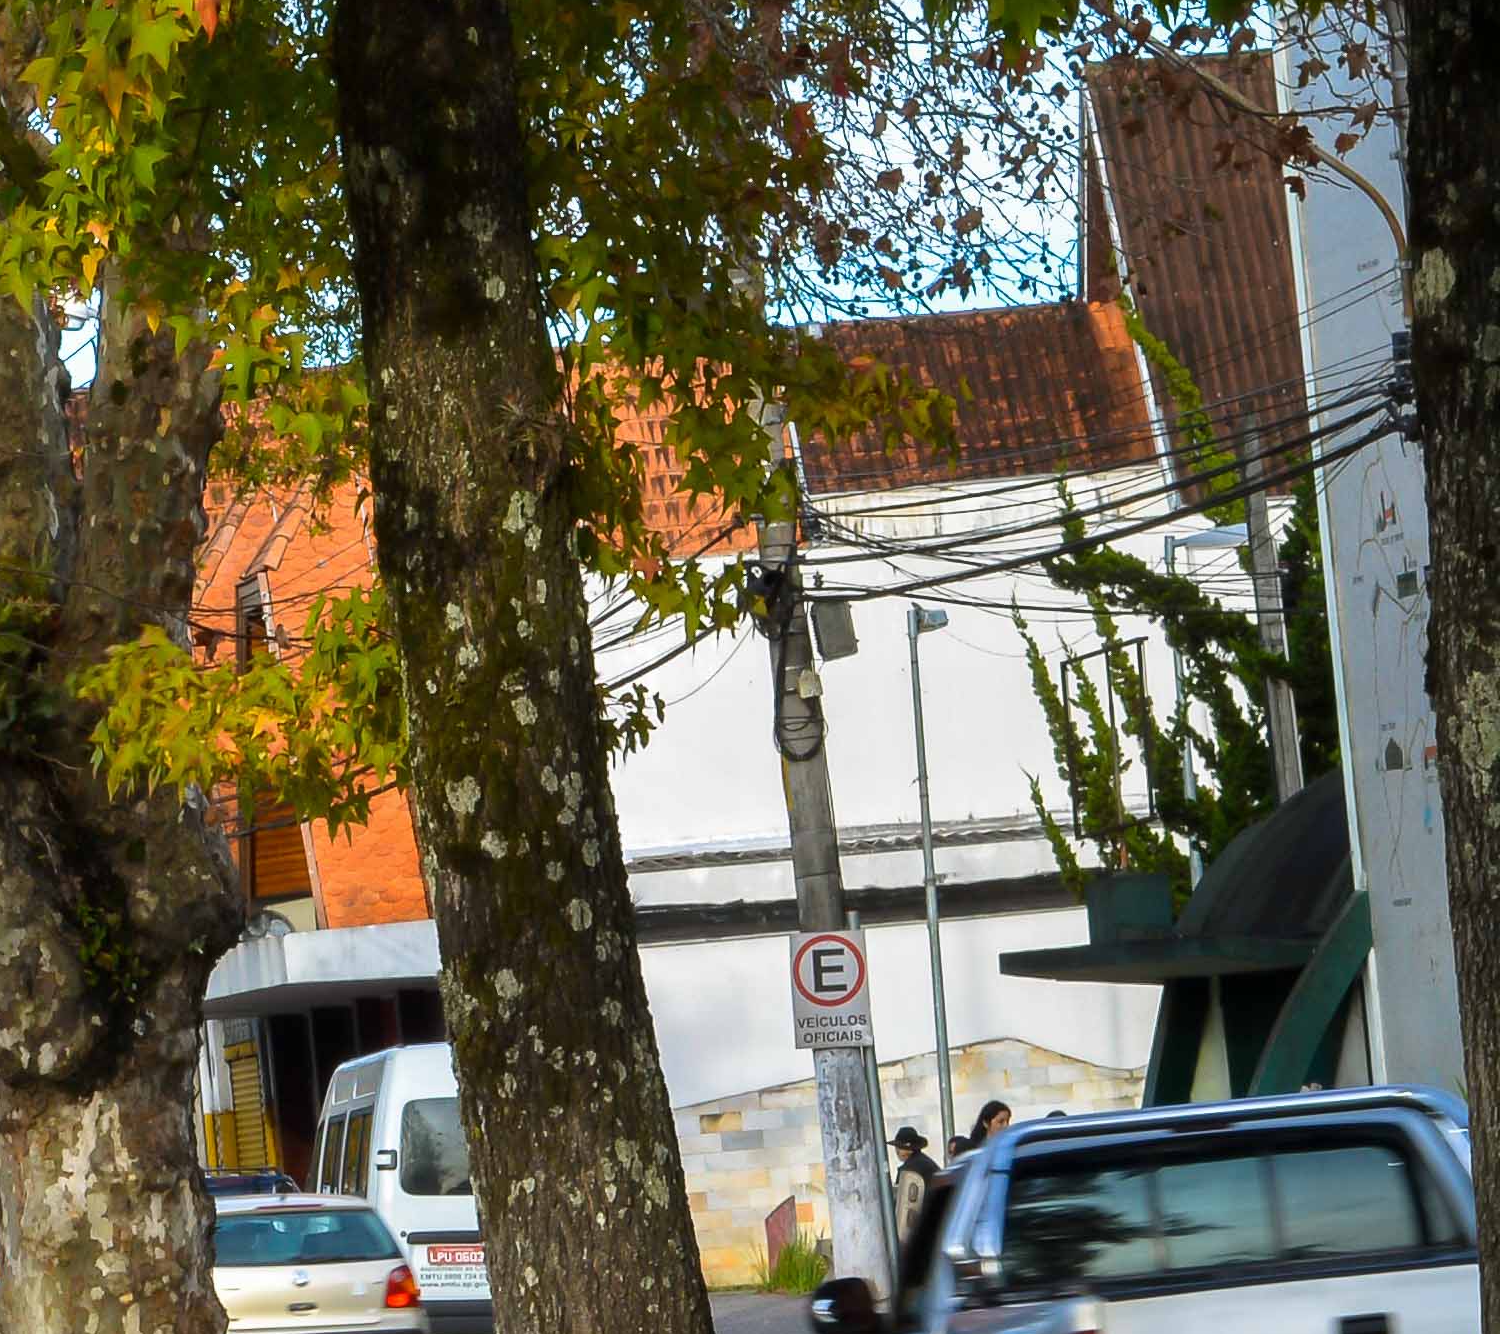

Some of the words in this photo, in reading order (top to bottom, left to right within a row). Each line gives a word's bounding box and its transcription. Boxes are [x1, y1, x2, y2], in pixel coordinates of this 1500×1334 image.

[811, 948, 848, 993] E
[797, 1013, 868, 1029] VEÍCULOS
[803, 1030, 863, 1044] OFICIAIS
